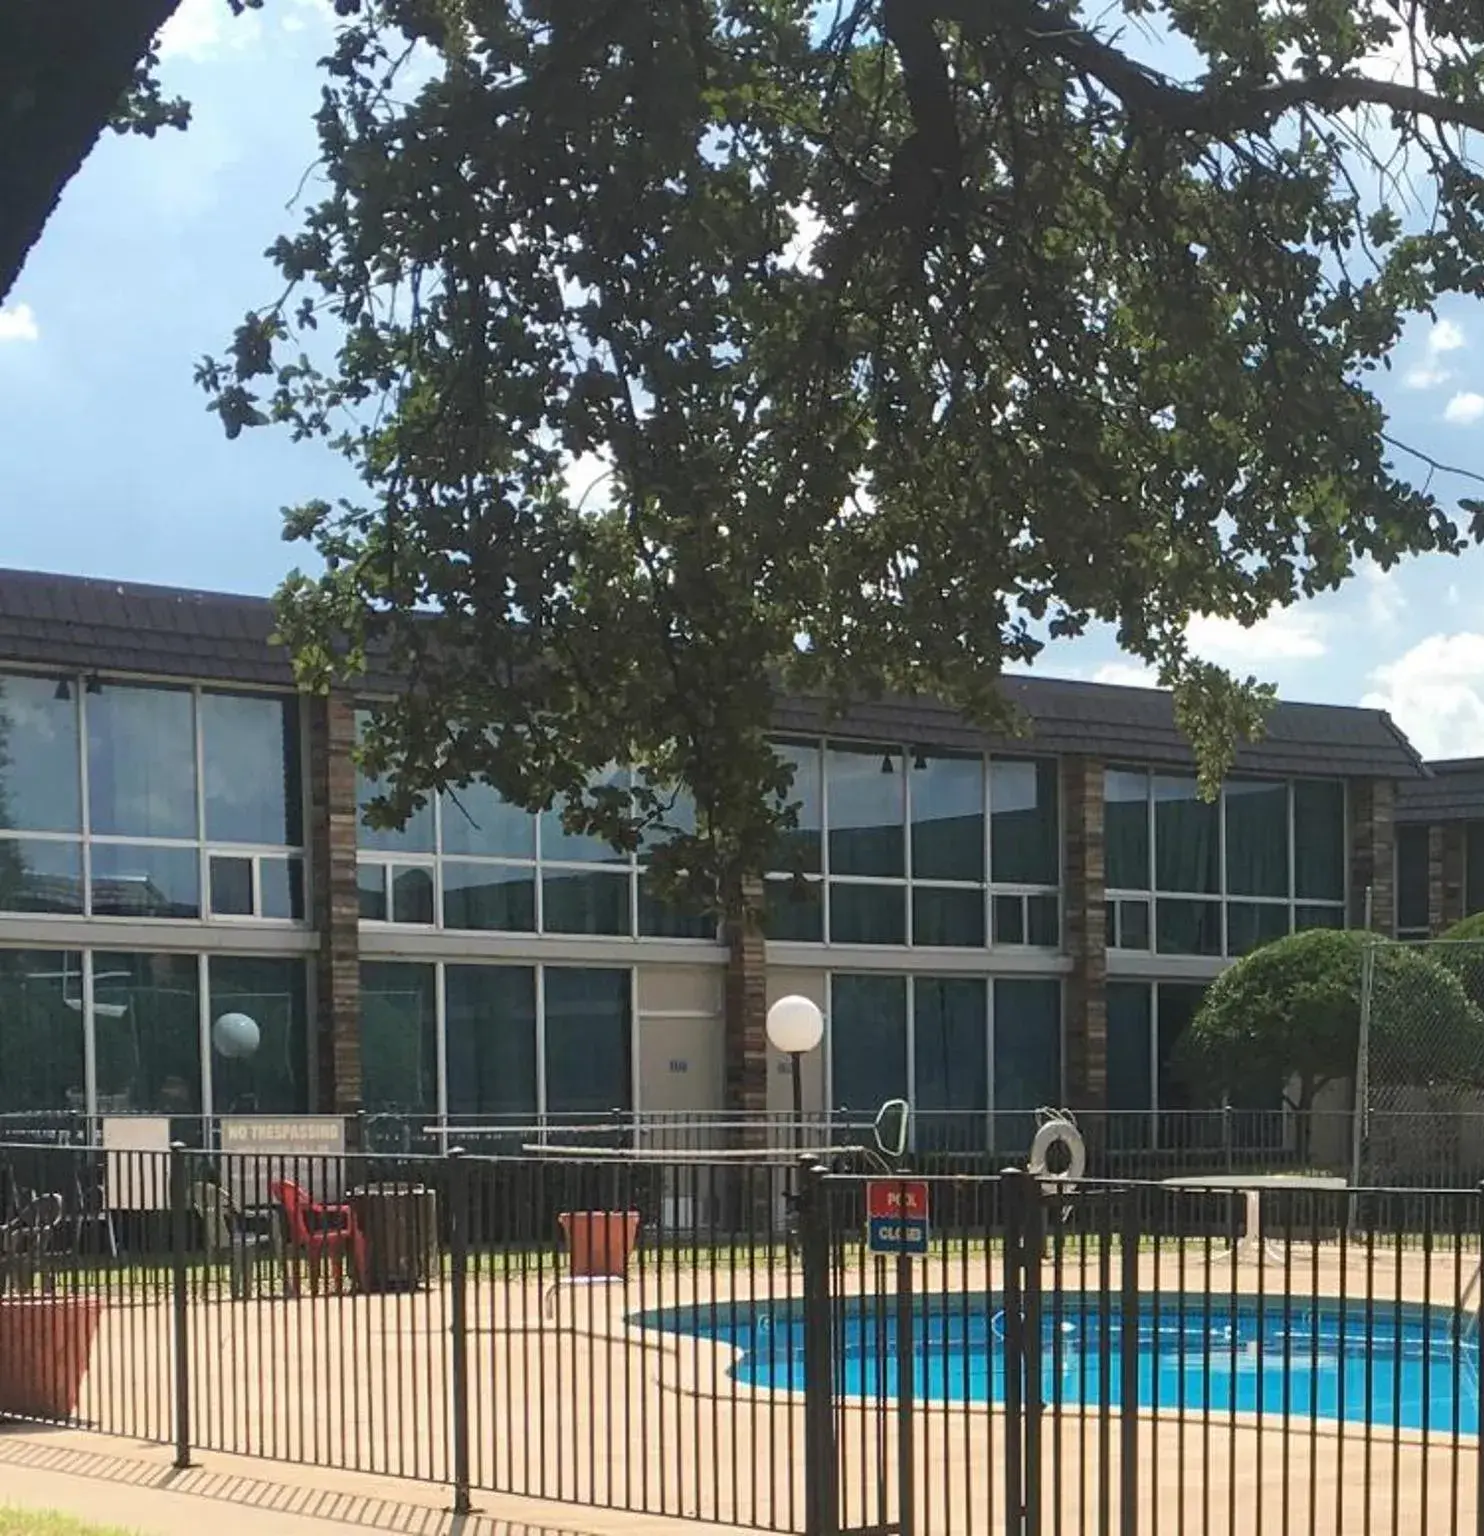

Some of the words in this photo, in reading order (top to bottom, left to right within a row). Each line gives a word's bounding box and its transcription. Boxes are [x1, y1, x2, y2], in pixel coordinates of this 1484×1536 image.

[228, 1124, 248, 1140] NO
[251, 1124, 339, 1140] TRESPASSING
[879, 1227, 922, 1241] CLOED
